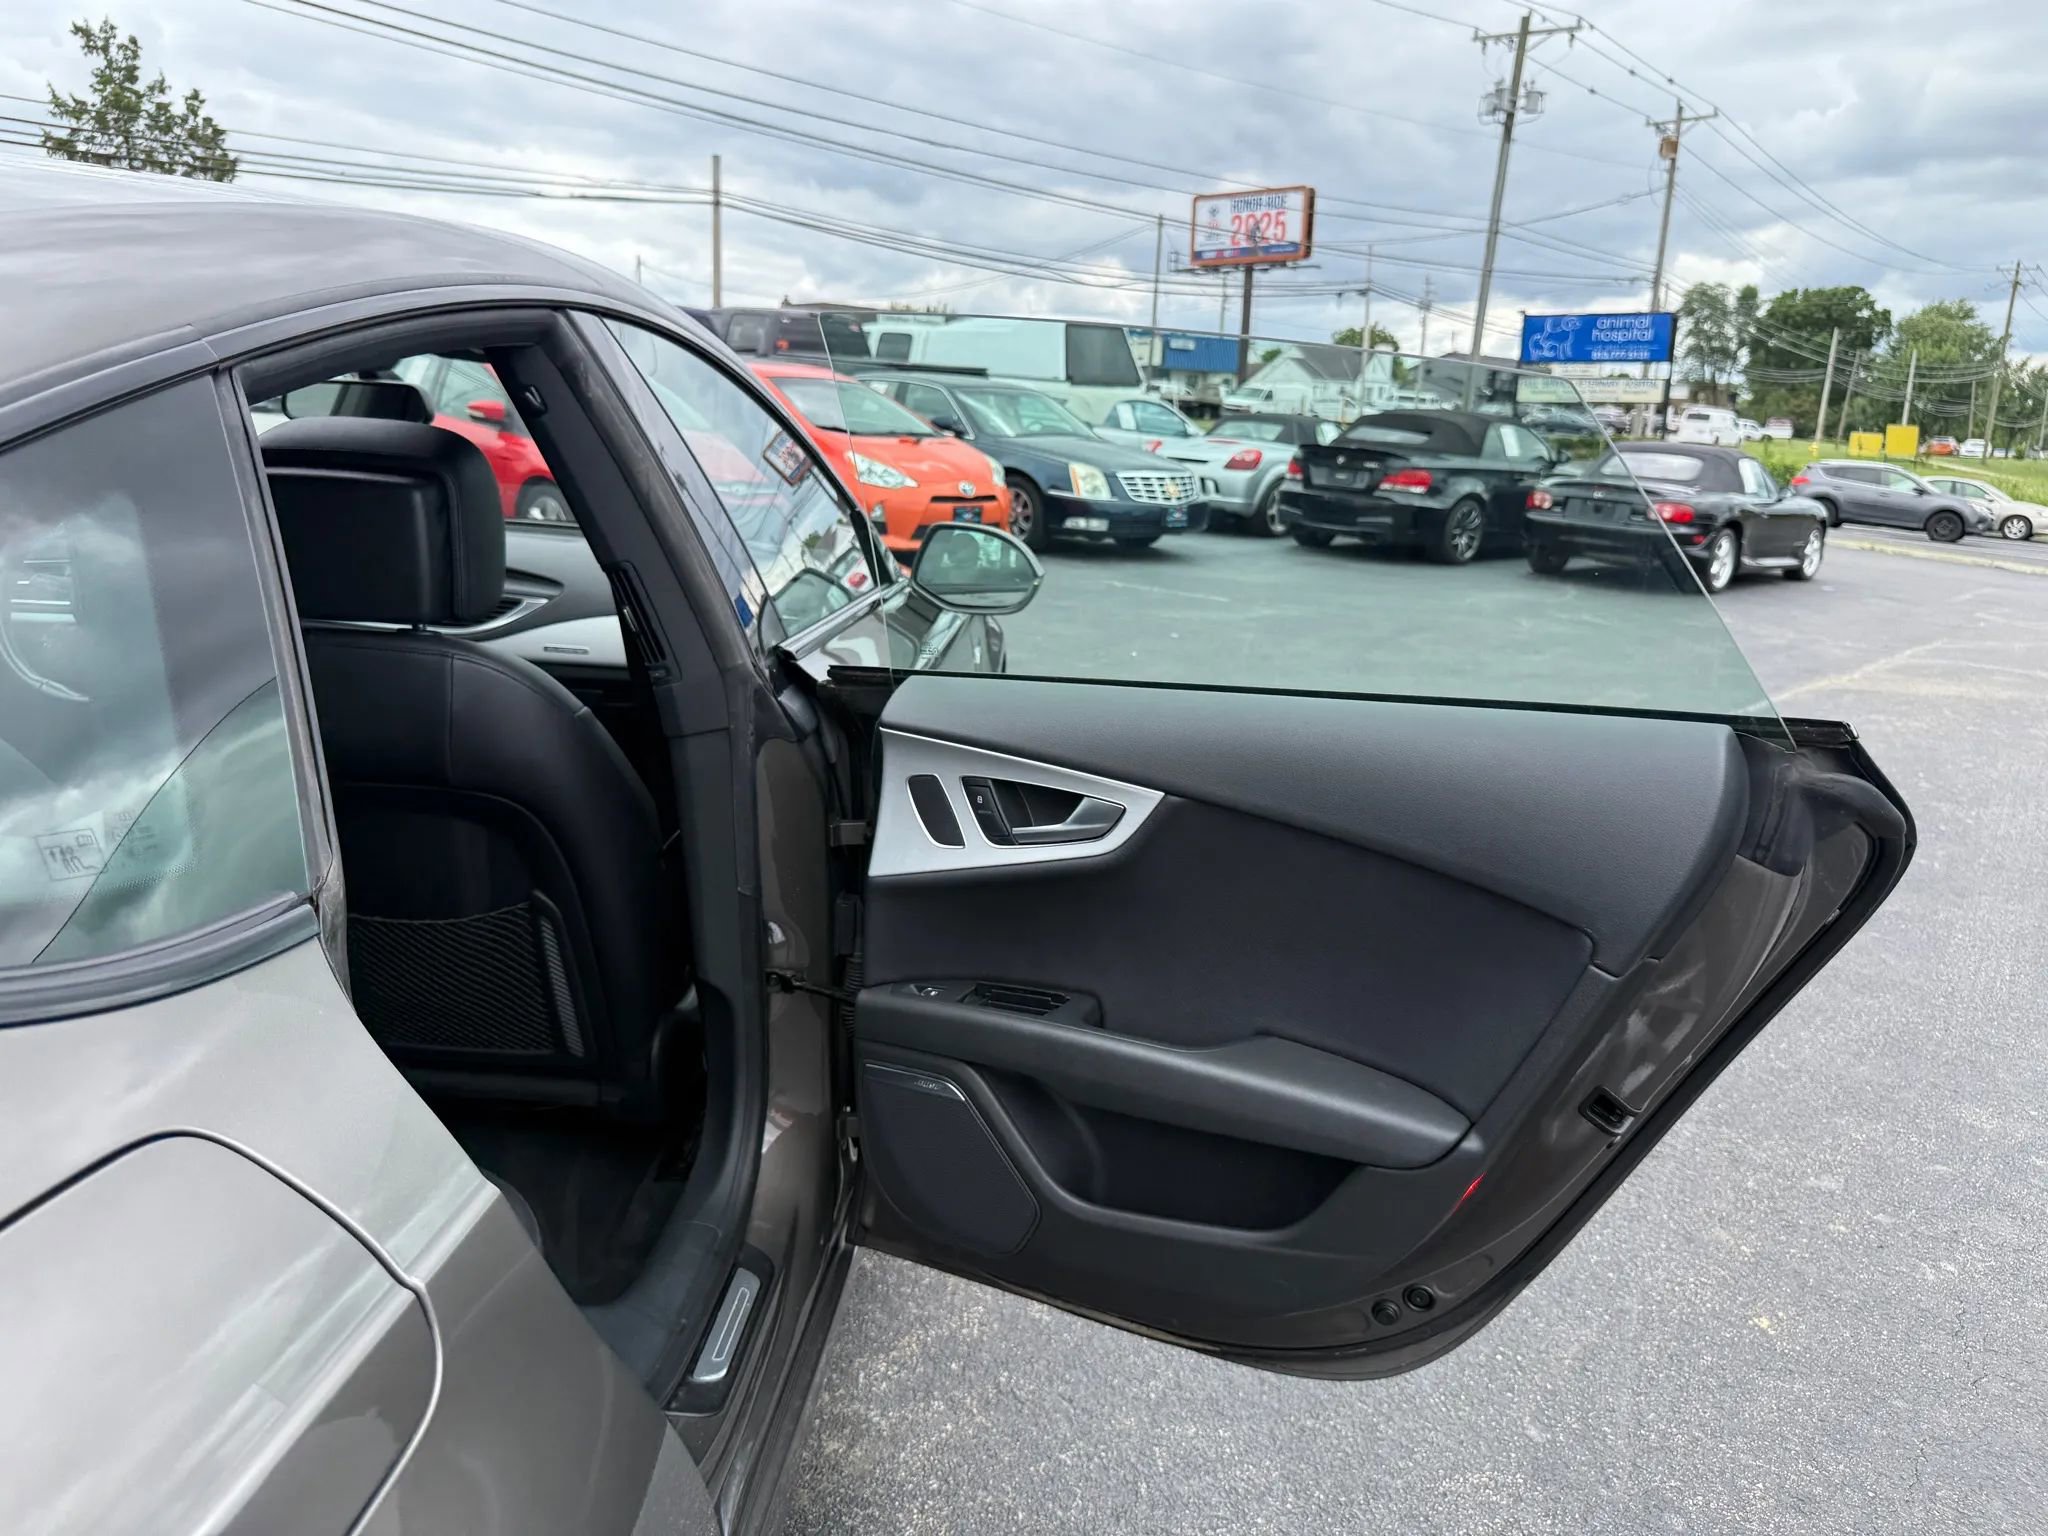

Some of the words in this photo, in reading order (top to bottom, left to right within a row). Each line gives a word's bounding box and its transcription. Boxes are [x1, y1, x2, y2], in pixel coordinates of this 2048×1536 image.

[1232, 210, 1286, 246] 2025
[1596, 315, 1651, 329] animal
[1592, 328, 1653, 343] hospital
